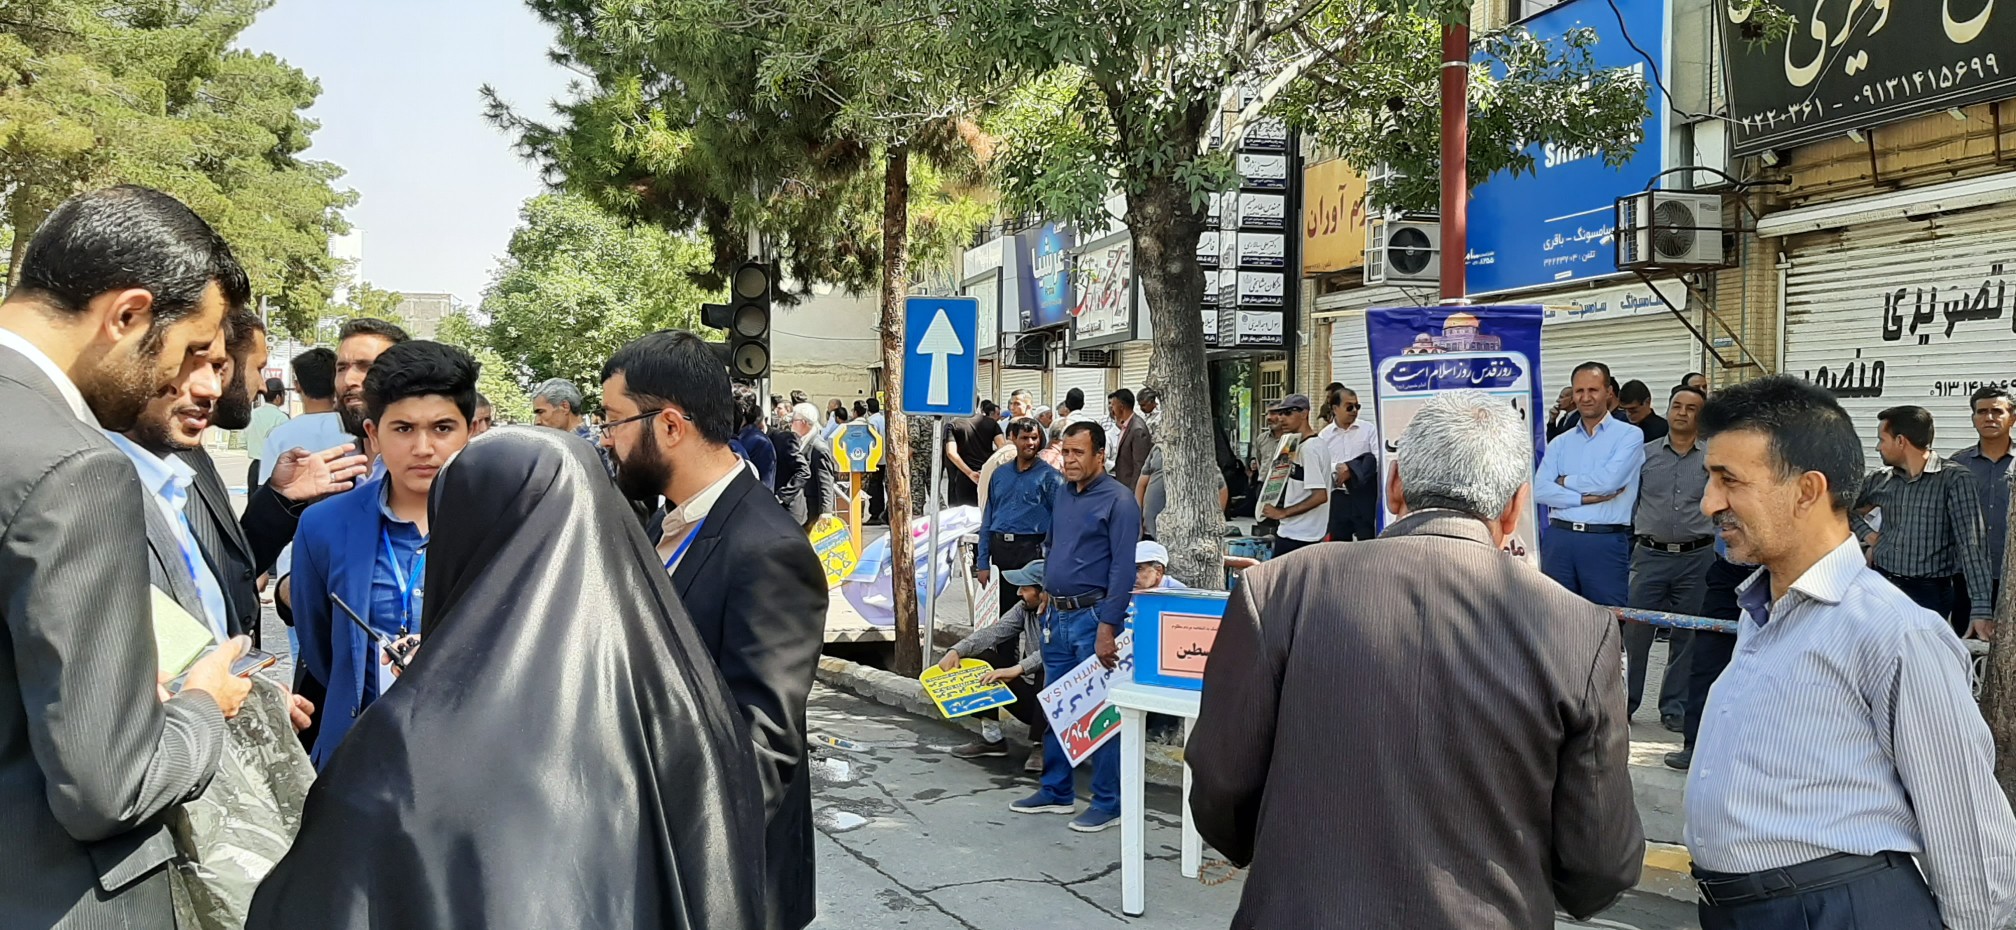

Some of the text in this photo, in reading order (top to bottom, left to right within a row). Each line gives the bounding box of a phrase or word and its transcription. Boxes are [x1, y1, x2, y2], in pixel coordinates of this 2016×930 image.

[1853, 52, 2000, 105] ۰۹۱۳۱۴۱۵۶۹۹
[1742, 98, 1823, 135] ۲۲۲۰۳۶۱
[1307, 183, 1347, 238] آوران
[1543, 233, 1564, 251] باقری
[1883, 264, 2005, 345] تصویری
[1393, 361, 1512, 390] روز قدس روز اسلام است
[1074, 660, 1101, 683] WITH
